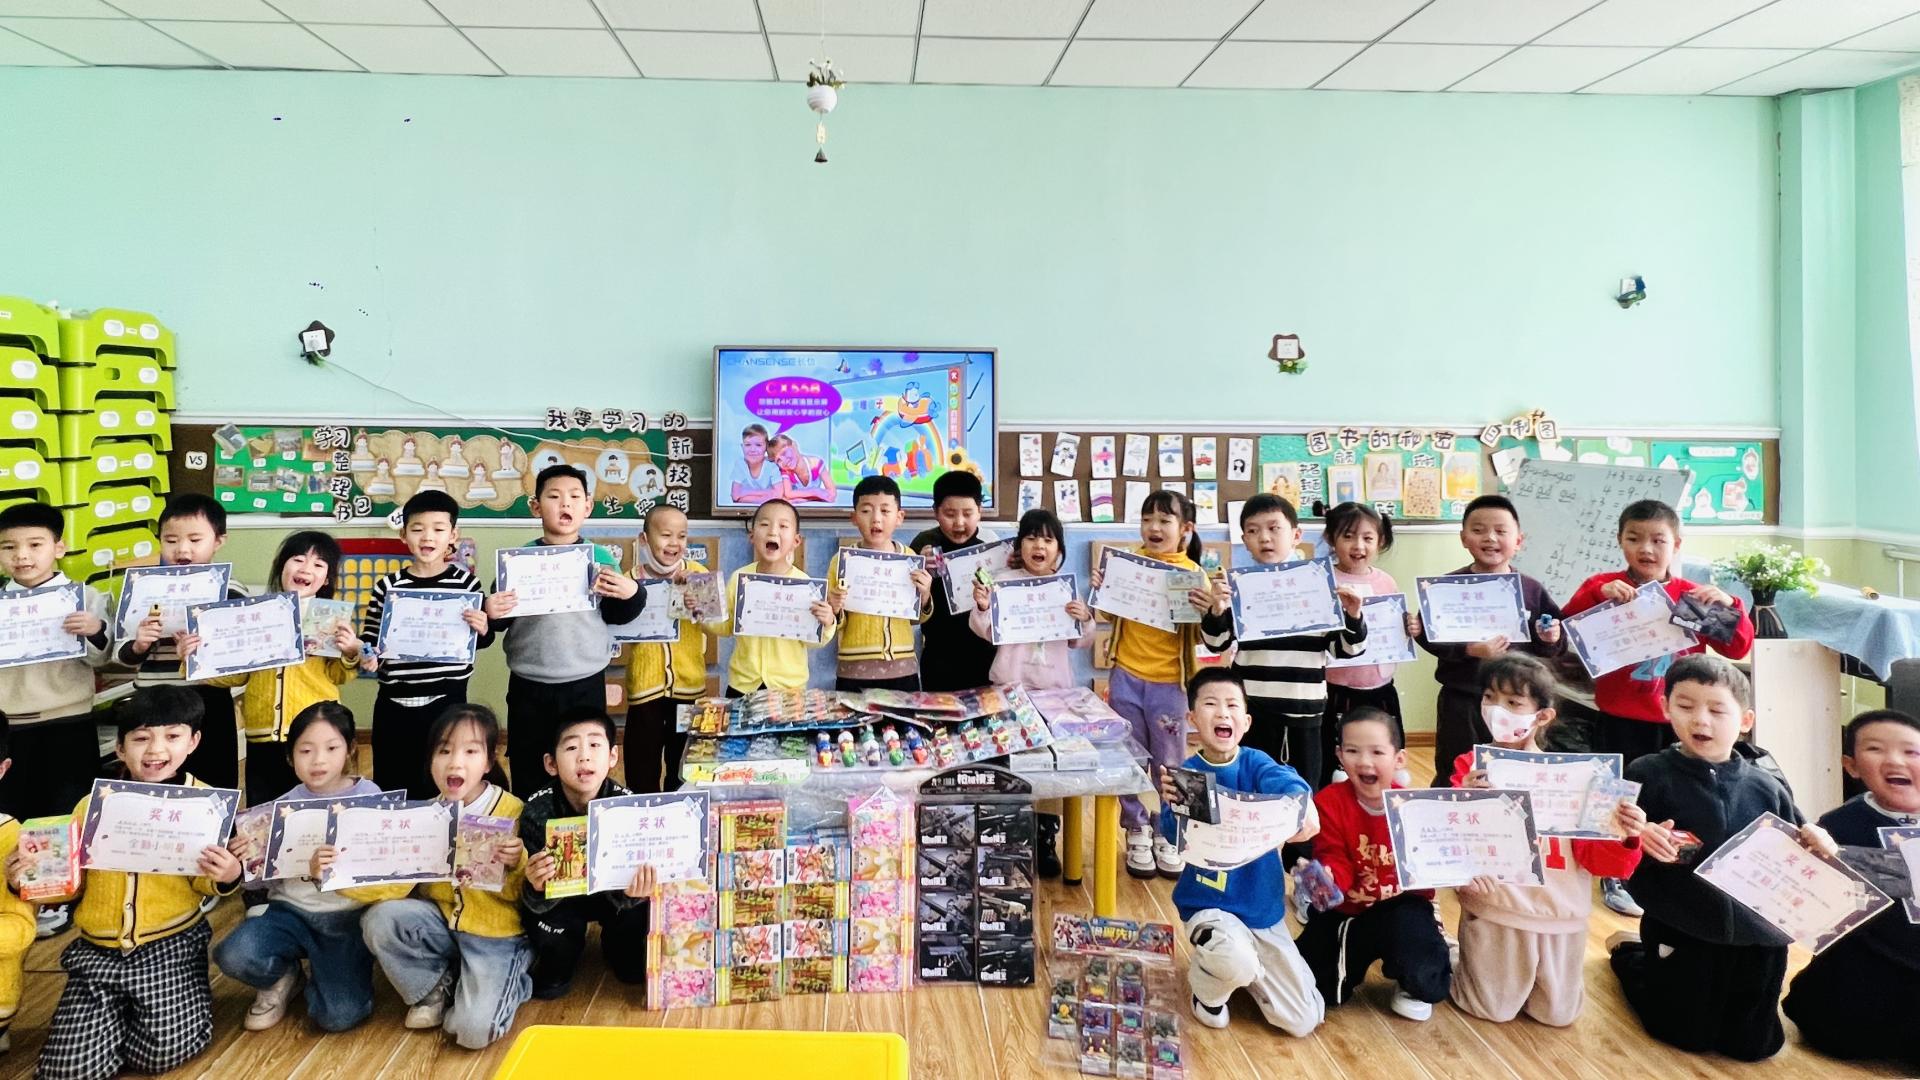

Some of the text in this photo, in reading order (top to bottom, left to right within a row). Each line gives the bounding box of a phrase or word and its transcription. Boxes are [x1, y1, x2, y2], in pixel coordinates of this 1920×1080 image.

[547, 408, 685, 431] 我要学习的
[1309, 429, 1455, 451] 图书的秘密
[188, 454, 203, 466] VS
[149, 808, 182, 822] 奖状
[1447, 810, 1480, 825] 奖状
[639, 817, 666, 831] 奖状
